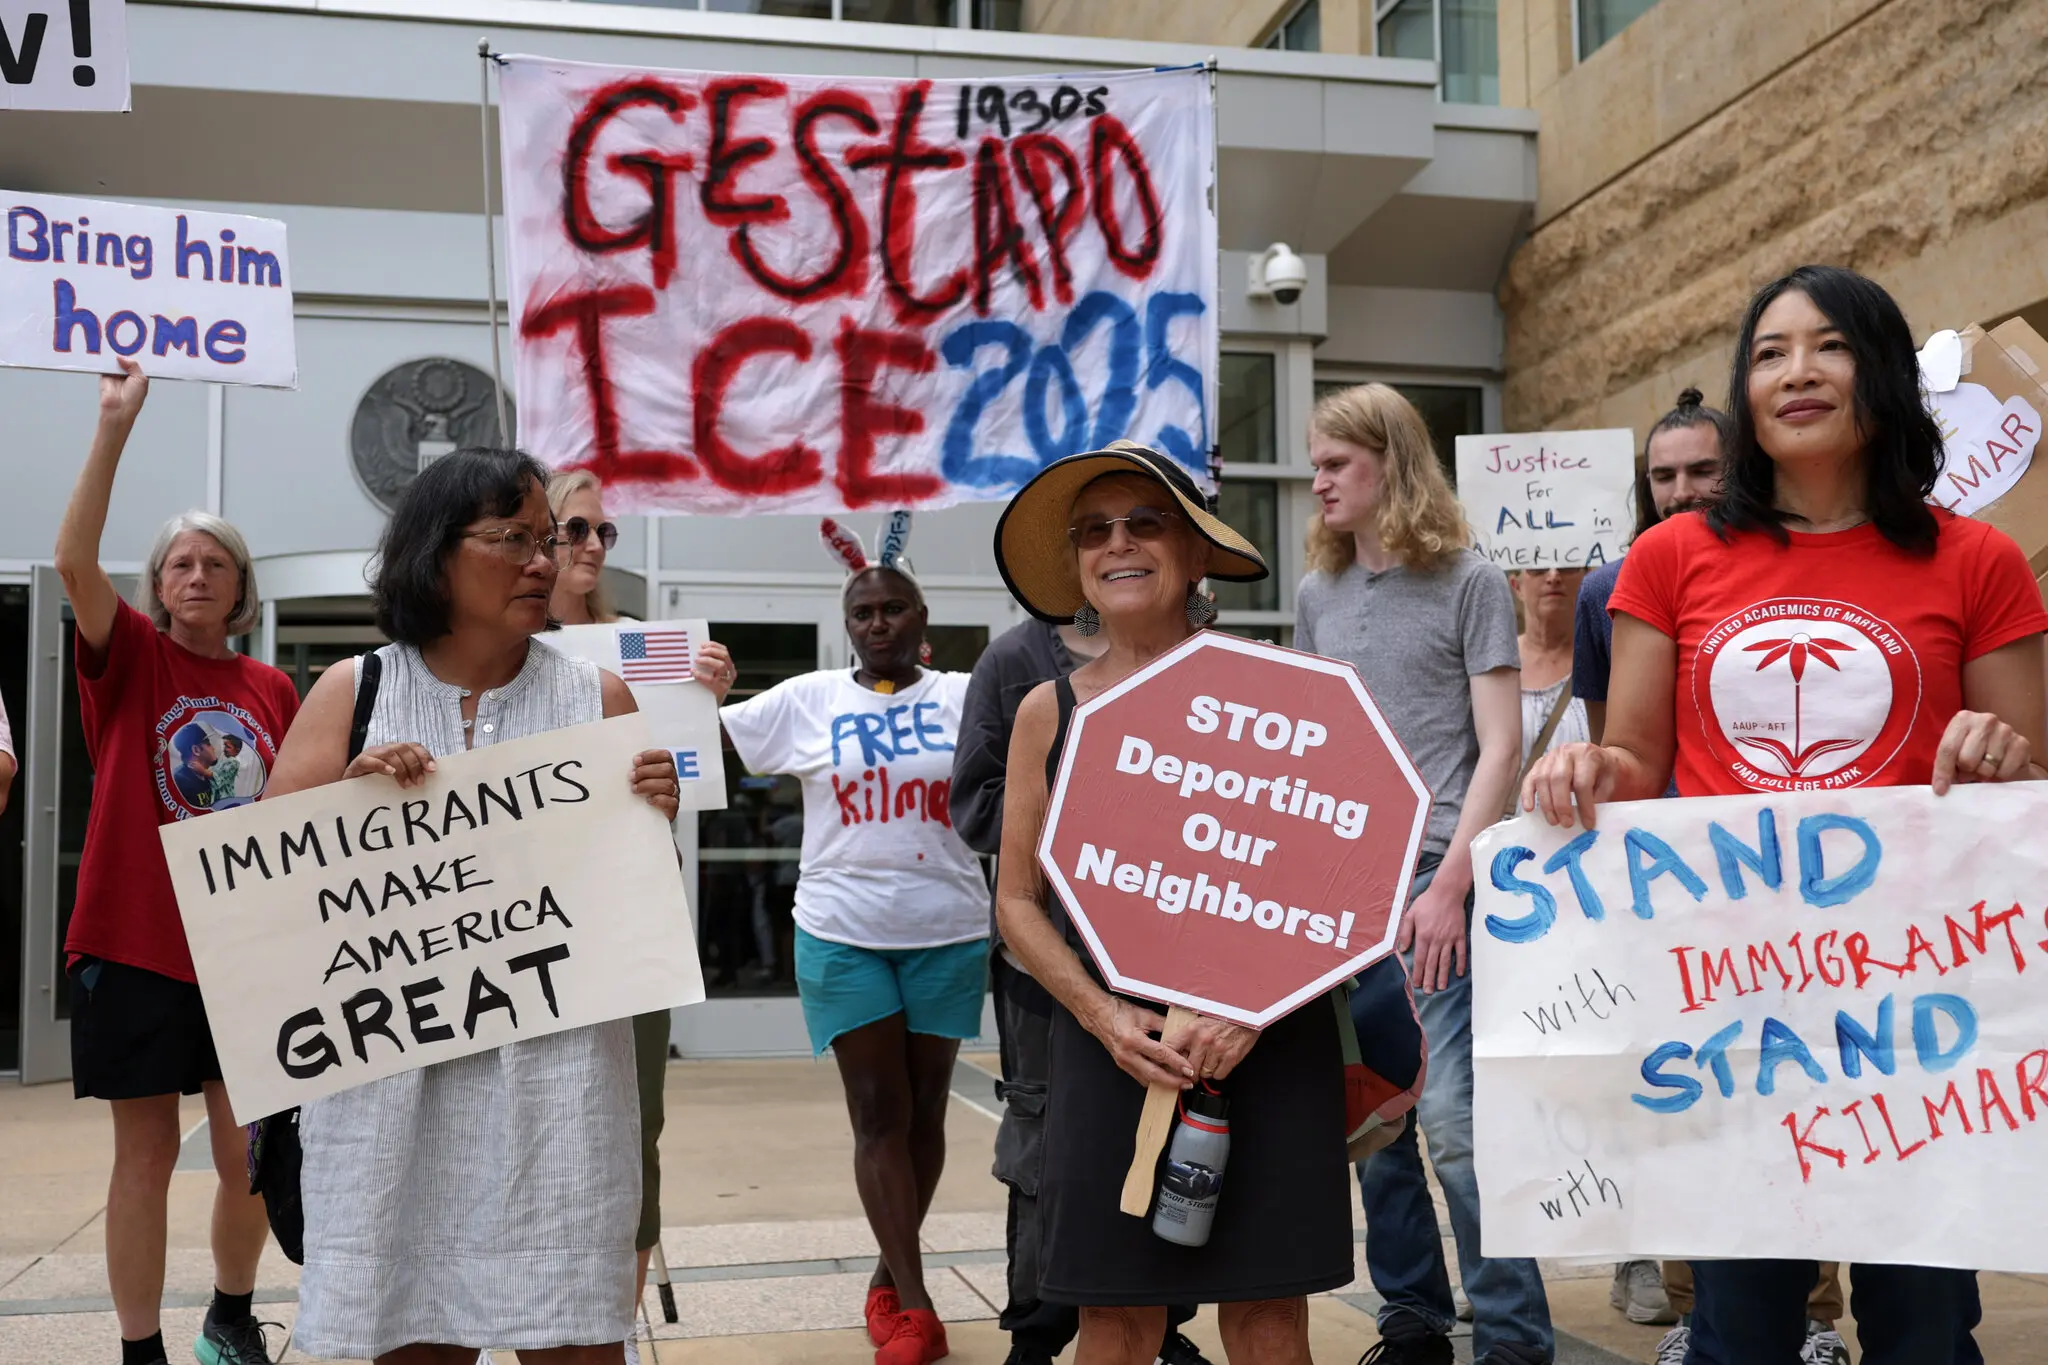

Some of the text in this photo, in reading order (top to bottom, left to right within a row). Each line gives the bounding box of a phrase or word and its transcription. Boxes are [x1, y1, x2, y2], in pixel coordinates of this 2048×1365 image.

[956, 84, 1108, 138] 1930s
[8, 206, 282, 287] Bring him
[53, 278, 247, 364] home
[520, 284, 1206, 511] ICE 2025
[1486, 445, 1591, 474] Justice
[1526, 481, 1554, 500] For
[1927, 413, 2033, 511] LMAR
[1496, 506, 1612, 535] ALL in
[1703, 603, 1902, 656] UNITED ACADEMICS OF MARYLAND
[831, 702, 954, 767] FREE
[1186, 695, 1328, 757] STOP
[1732, 721, 1758, 731] AAUP
[1768, 722, 1786, 731] AFT
[156, 768, 178, 811] Home
[676, 751, 700, 778] E
[831, 766, 953, 829] kilma
[1115, 735, 1370, 840] Deporting
[1731, 761, 1862, 792] UMD COLLEGE PARK
[198, 760, 591, 896] IMMIGRANTS
[1182, 812, 1278, 867] Our
[318, 854, 495, 923] MAKE
[1074, 842, 1356, 950] Neighbors!
[1485, 807, 1882, 944] STAND
[322, 885, 573, 984] AMERICA
[1523, 900, 2048, 1036] with IMMIGRANT
[276, 942, 571, 1080] GREAT
[1631, 993, 1979, 1114] STAND
[1539, 1048, 2048, 1222] with KILMAR
